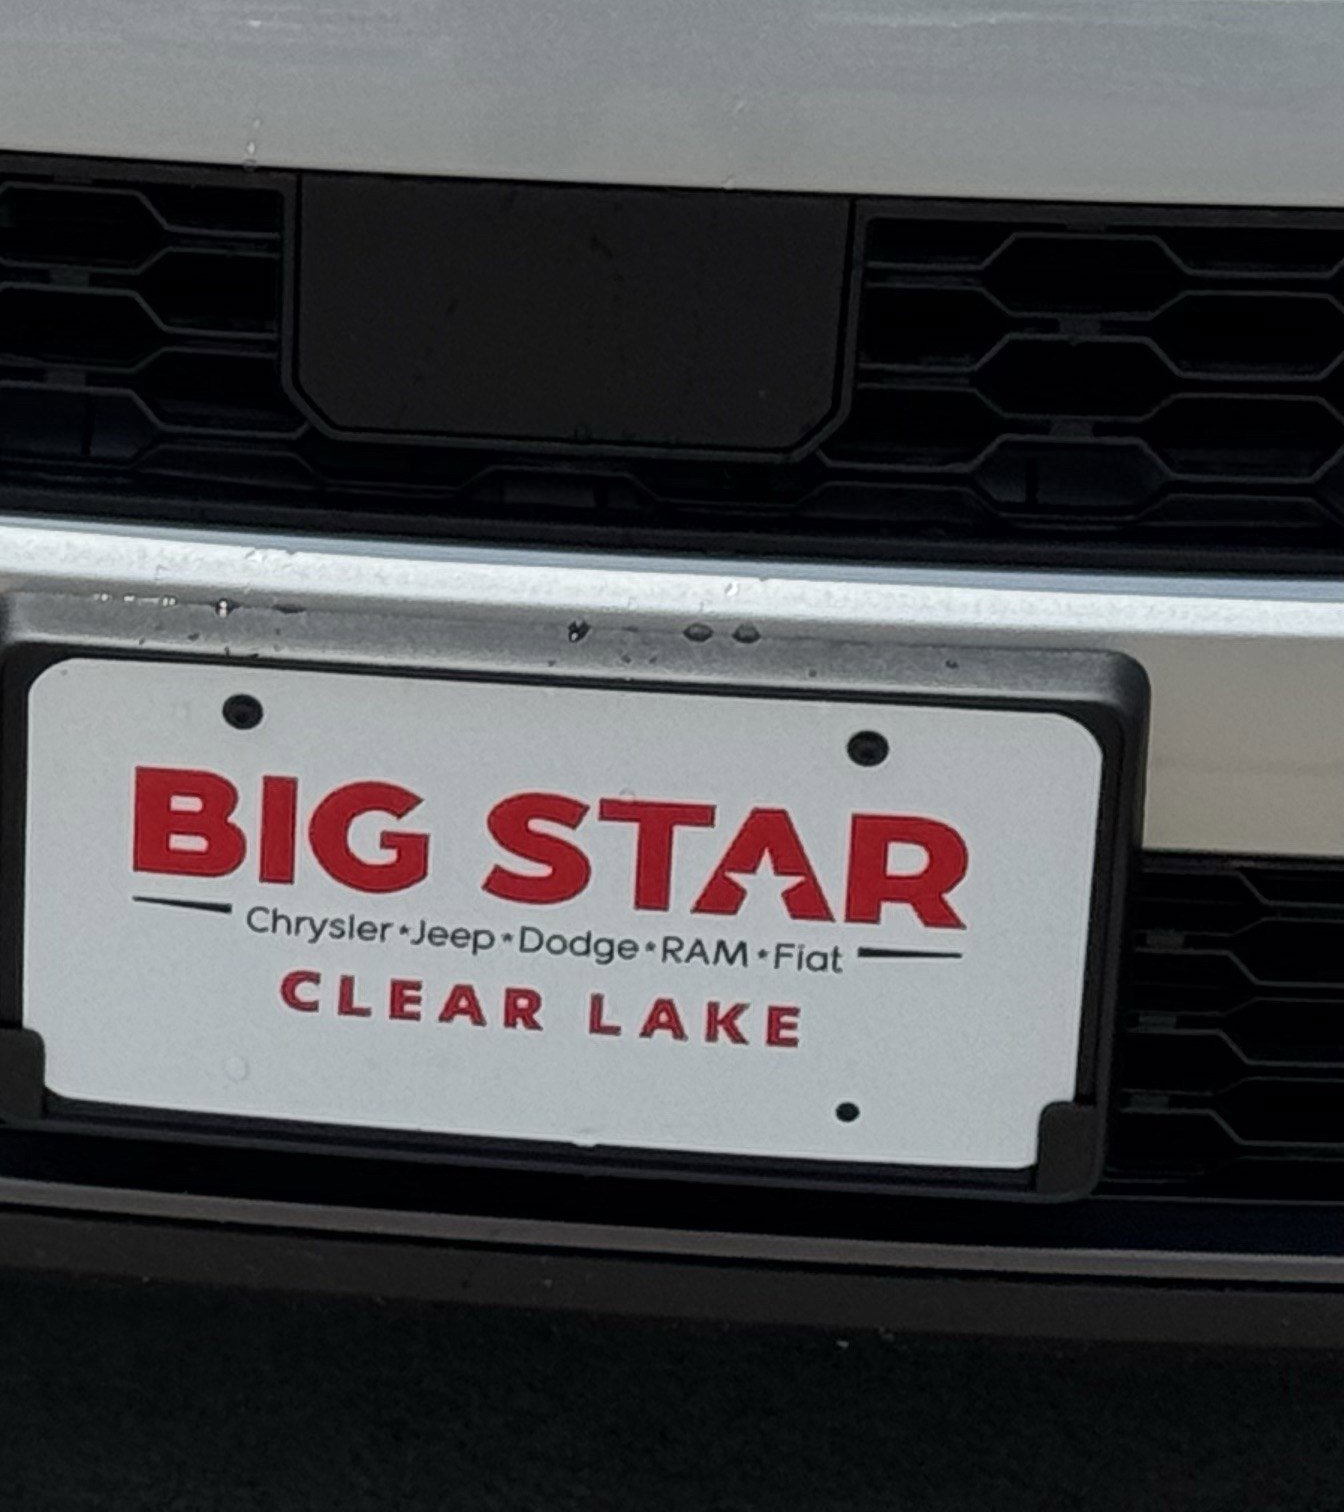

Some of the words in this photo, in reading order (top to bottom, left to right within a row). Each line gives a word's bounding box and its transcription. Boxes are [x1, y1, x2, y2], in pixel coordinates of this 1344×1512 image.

[131, 766, 430, 894] BIG
[482, 790, 968, 929] STAR
[246, 905, 393, 944] Chrysler
[411, 919, 496, 956] Jeep
[519, 925, 639, 965] Dodge
[661, 935, 749, 968] RAM
[774, 942, 844, 974] Fiat
[279, 969, 544, 1032] CLEAR
[588, 992, 802, 1048] LAKE
